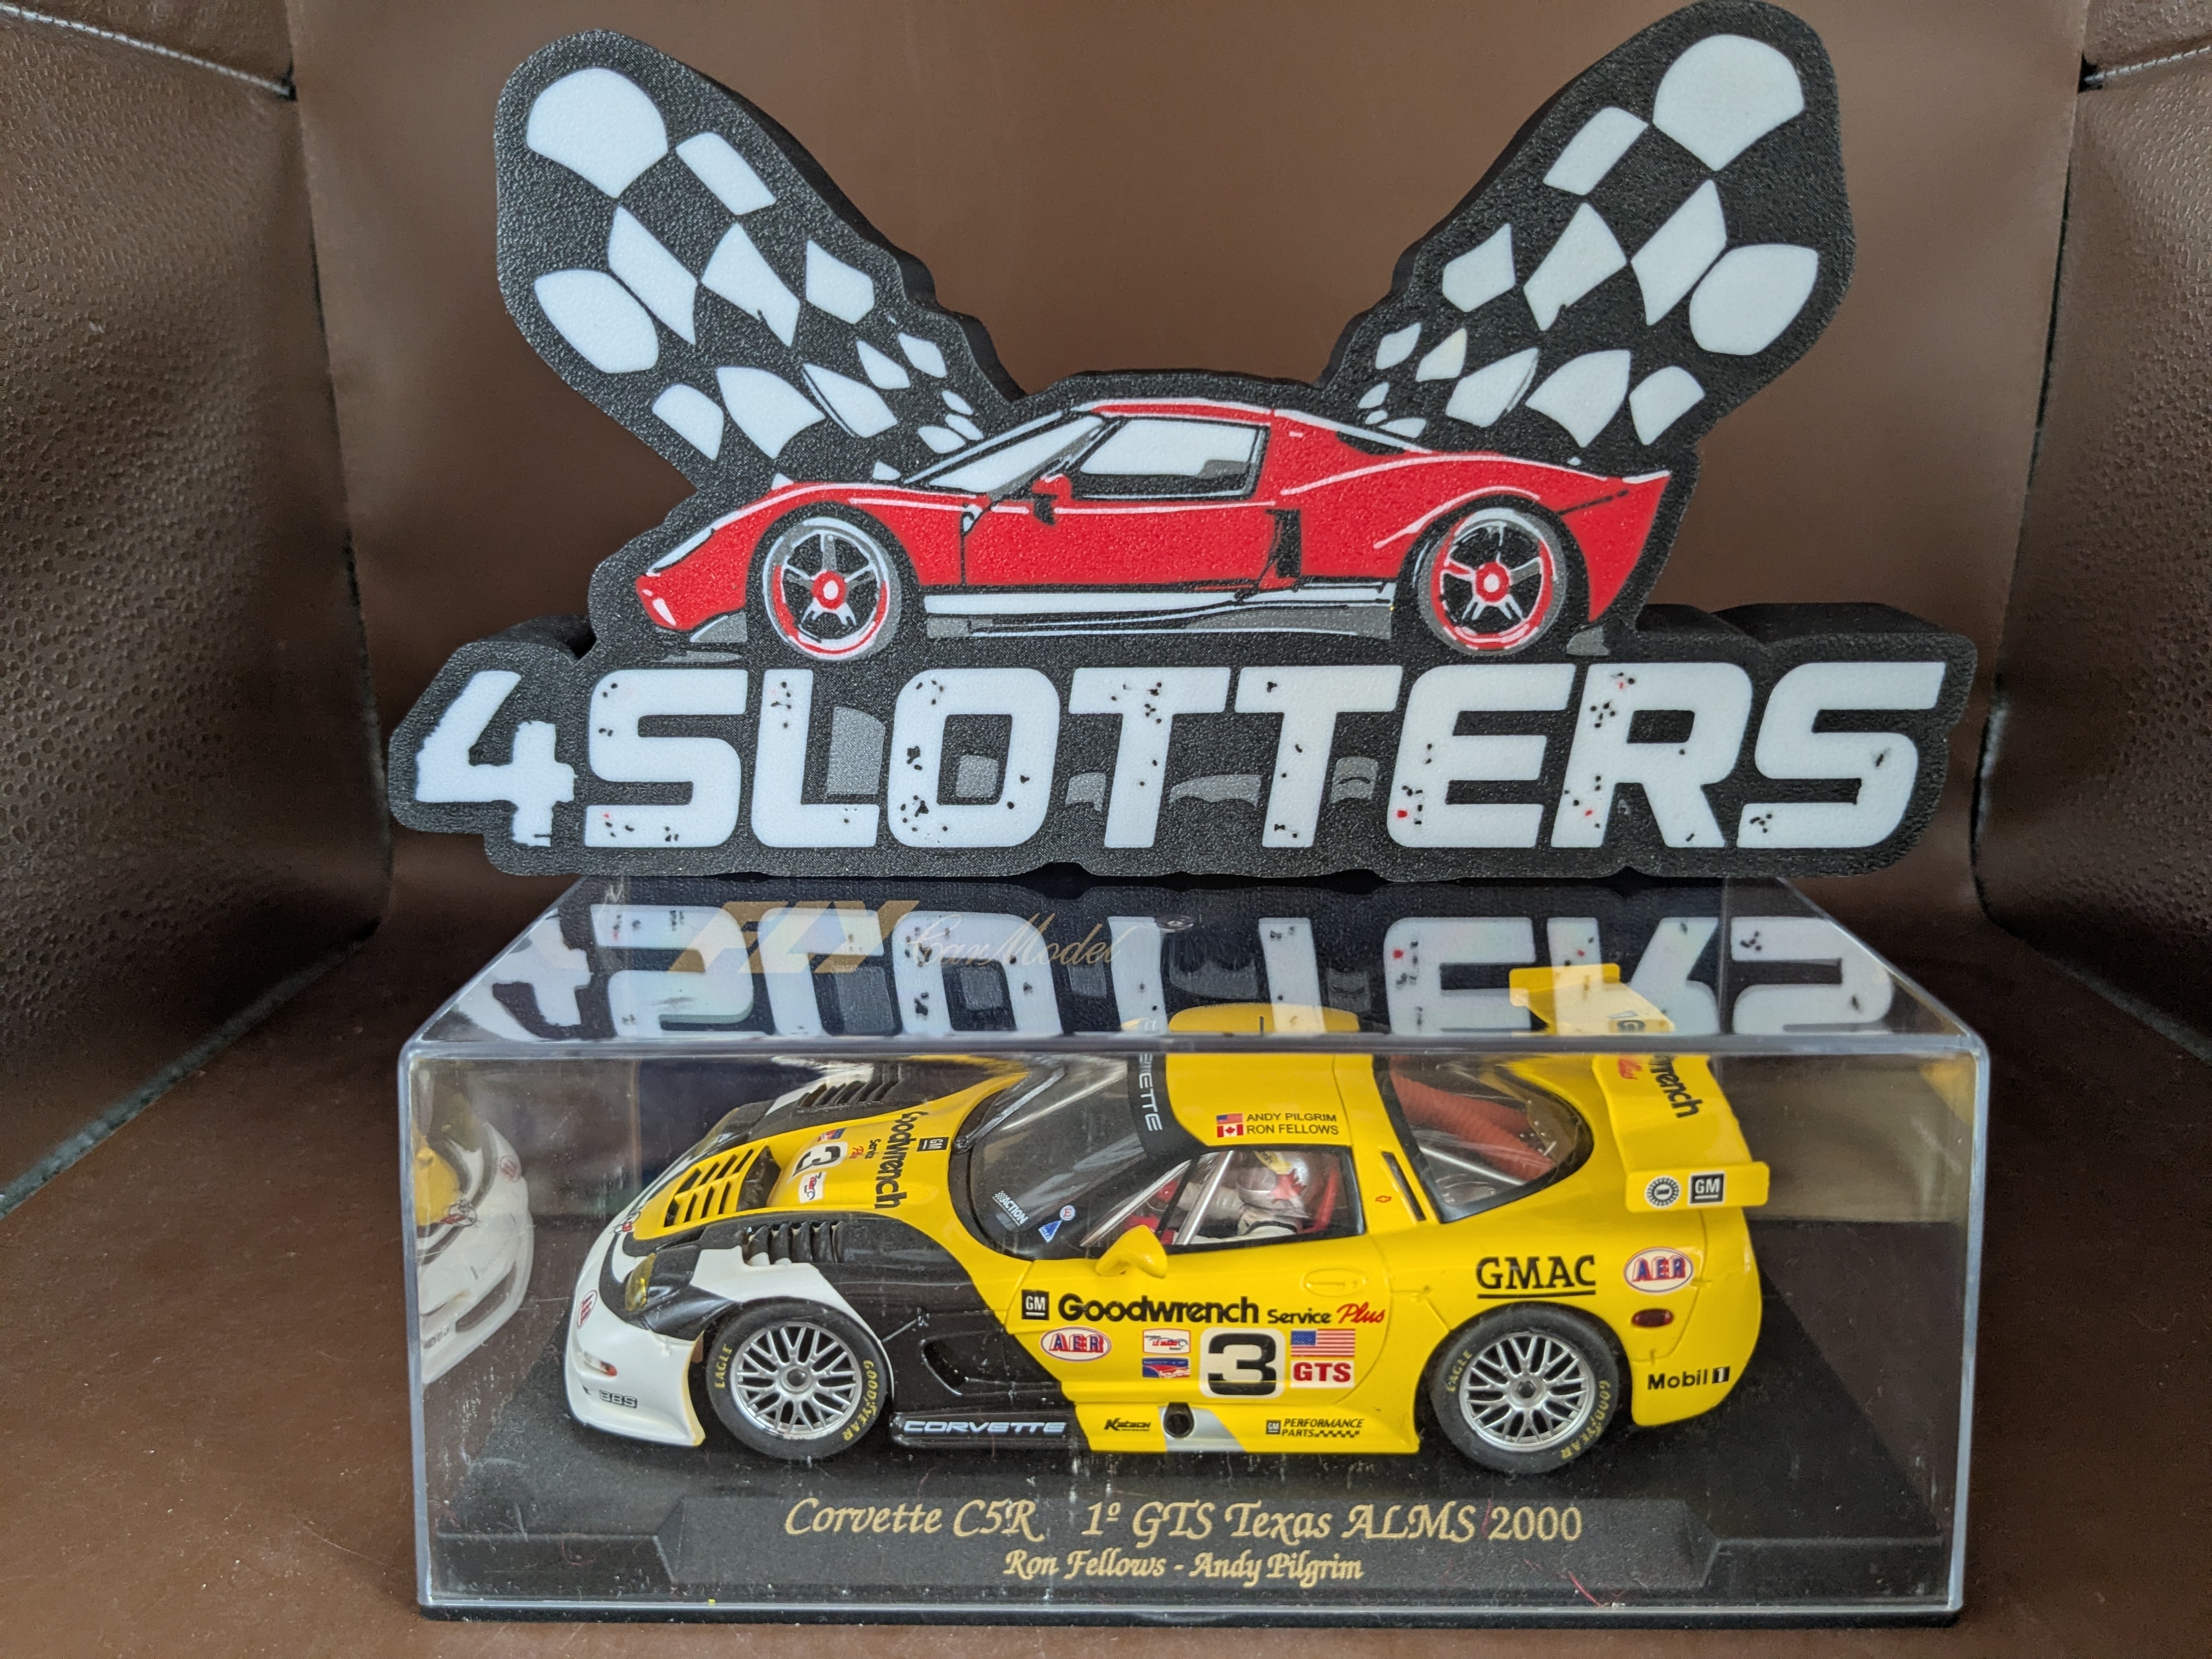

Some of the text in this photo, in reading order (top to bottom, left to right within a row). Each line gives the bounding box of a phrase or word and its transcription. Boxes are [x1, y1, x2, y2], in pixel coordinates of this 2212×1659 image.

[414, 661, 1946, 848] 4SLOTTERS
[1246, 1113, 1337, 1122] ANDY PILGRIM
[1246, 1125, 1339, 1135] RON FELLOWS
[792, 1145, 840, 1177] 3
[874, 1111, 929, 1209] Goodwrench
[1695, 1177, 1721, 1194] GM
[1001, 1197, 1029, 1224] ACTION
[1476, 1255, 1596, 1290] GMAC
[1632, 1256, 1687, 1283] AER
[1025, 1293, 1385, 1324] GM Goodwrench Service Plus
[1049, 1332, 1104, 1353] AER
[1207, 1333, 1277, 1396] 3
[1293, 1362, 1351, 1383] GTS
[1647, 1368, 1708, 1390] Mobil
[904, 1420, 1066, 1434] CORVETTE
[1268, 1418, 1364, 1430] GM PERFORMANCE
[785, 1497, 943, 1535] Corvette
[953, 1498, 1045, 1542] C5R
[1132, 1498, 1216, 1549] GTS
[1224, 1499, 1333, 1546] Texas
[1341, 1500, 1476, 1543] ALMS
[1488, 1506, 1583, 1541] 2000
[1003, 1548, 1059, 1580] Ron
[1063, 1548, 1167, 1580] Fellows
[1189, 1548, 1261, 1588] Andy
[1267, 1549, 1364, 1589] Pilgrim
